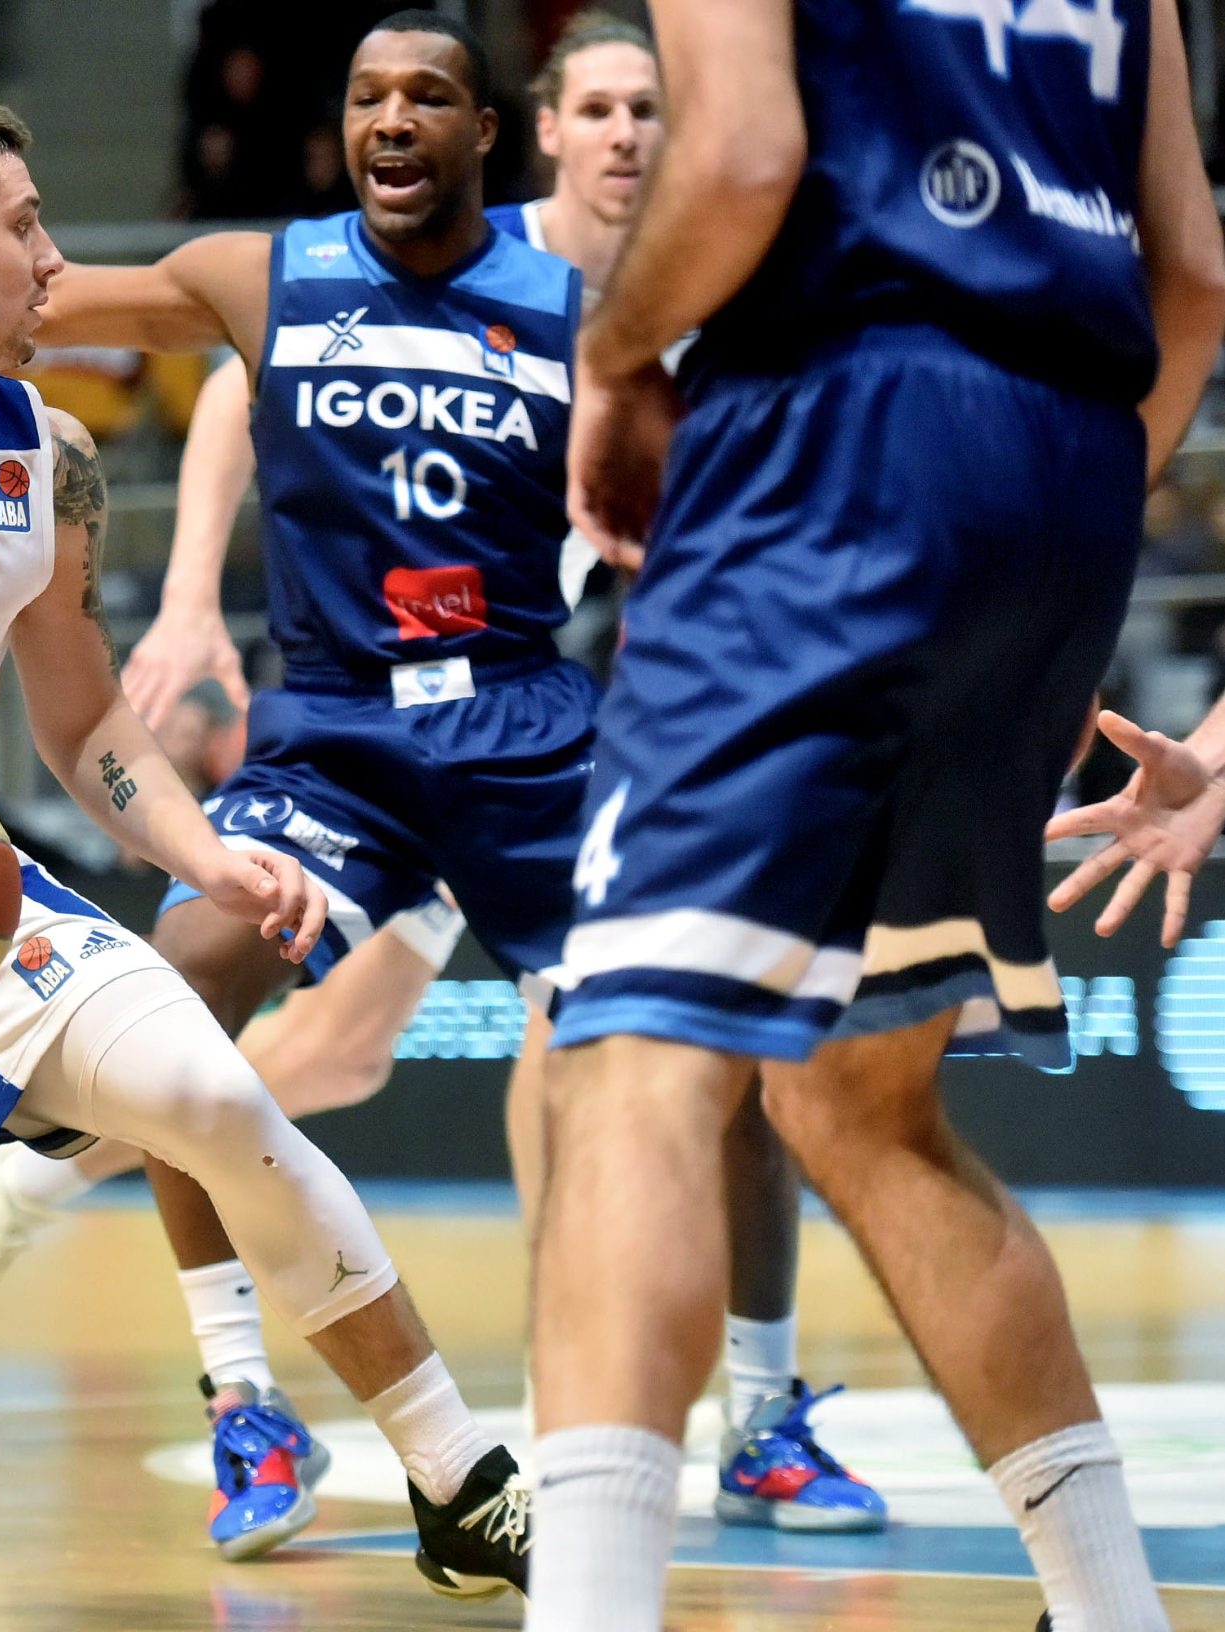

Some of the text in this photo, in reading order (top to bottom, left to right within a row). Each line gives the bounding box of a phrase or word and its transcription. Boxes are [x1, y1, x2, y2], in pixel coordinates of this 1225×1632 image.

[296, 379, 539, 451] IGOKEA
[380, 446, 467, 520] 10
[572, 776, 633, 908] 4
[33, 959, 71, 998] ABA
[79, 940, 132, 960] adidas
